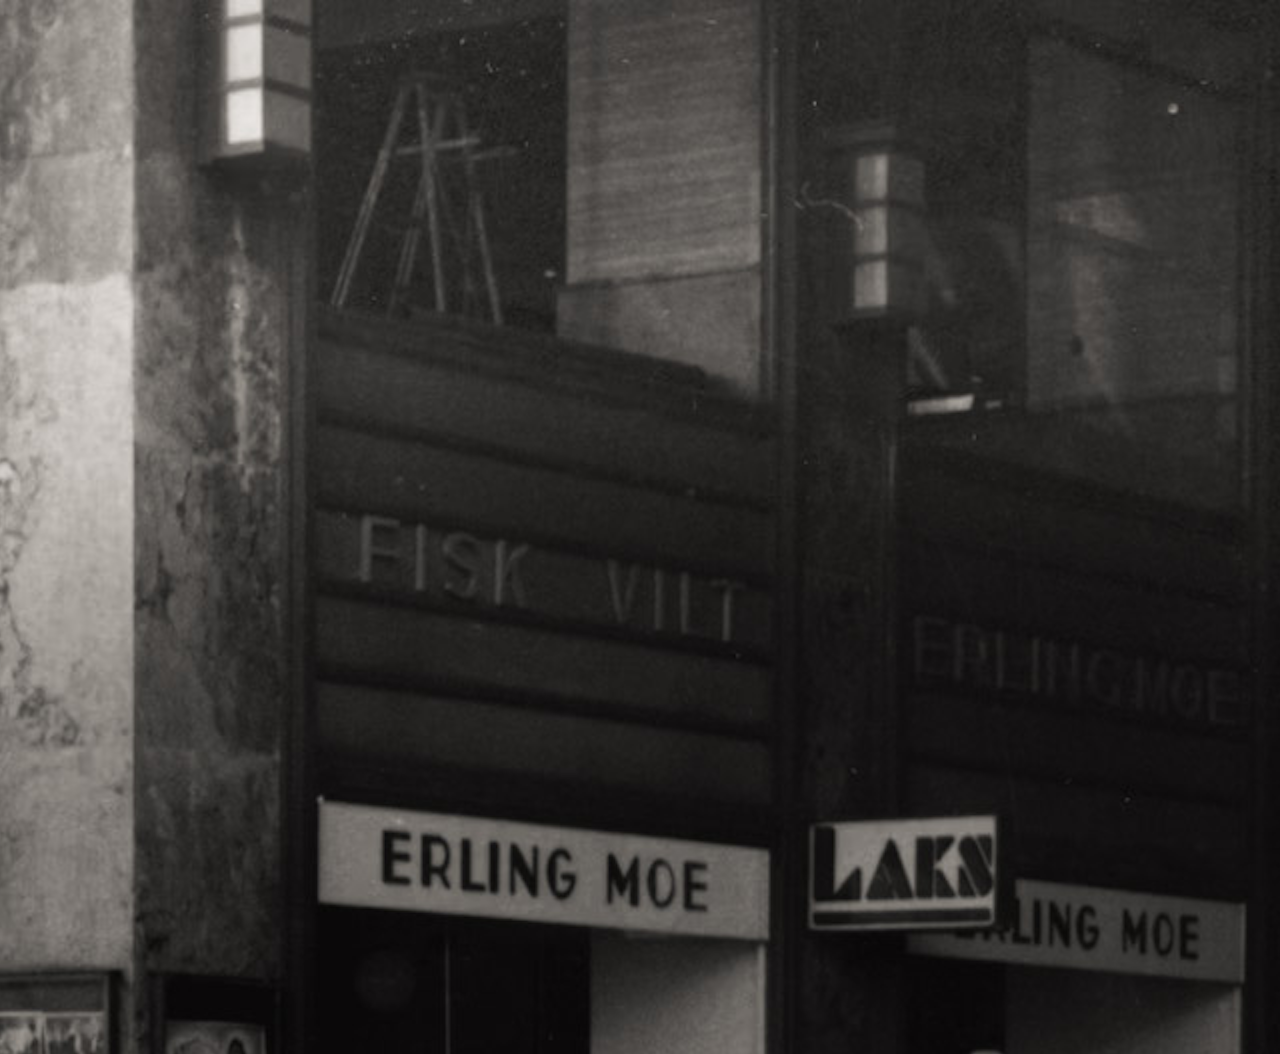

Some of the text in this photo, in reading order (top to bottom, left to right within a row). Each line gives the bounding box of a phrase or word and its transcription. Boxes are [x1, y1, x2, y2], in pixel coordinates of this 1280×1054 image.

[357, 514, 747, 641] FISK VILT
[914, 615, 1249, 724] ERLING MOE
[382, 830, 709, 912] ERLING MOE
[815, 826, 993, 900] LAKS
[953, 896, 1200, 960] LING MOE
